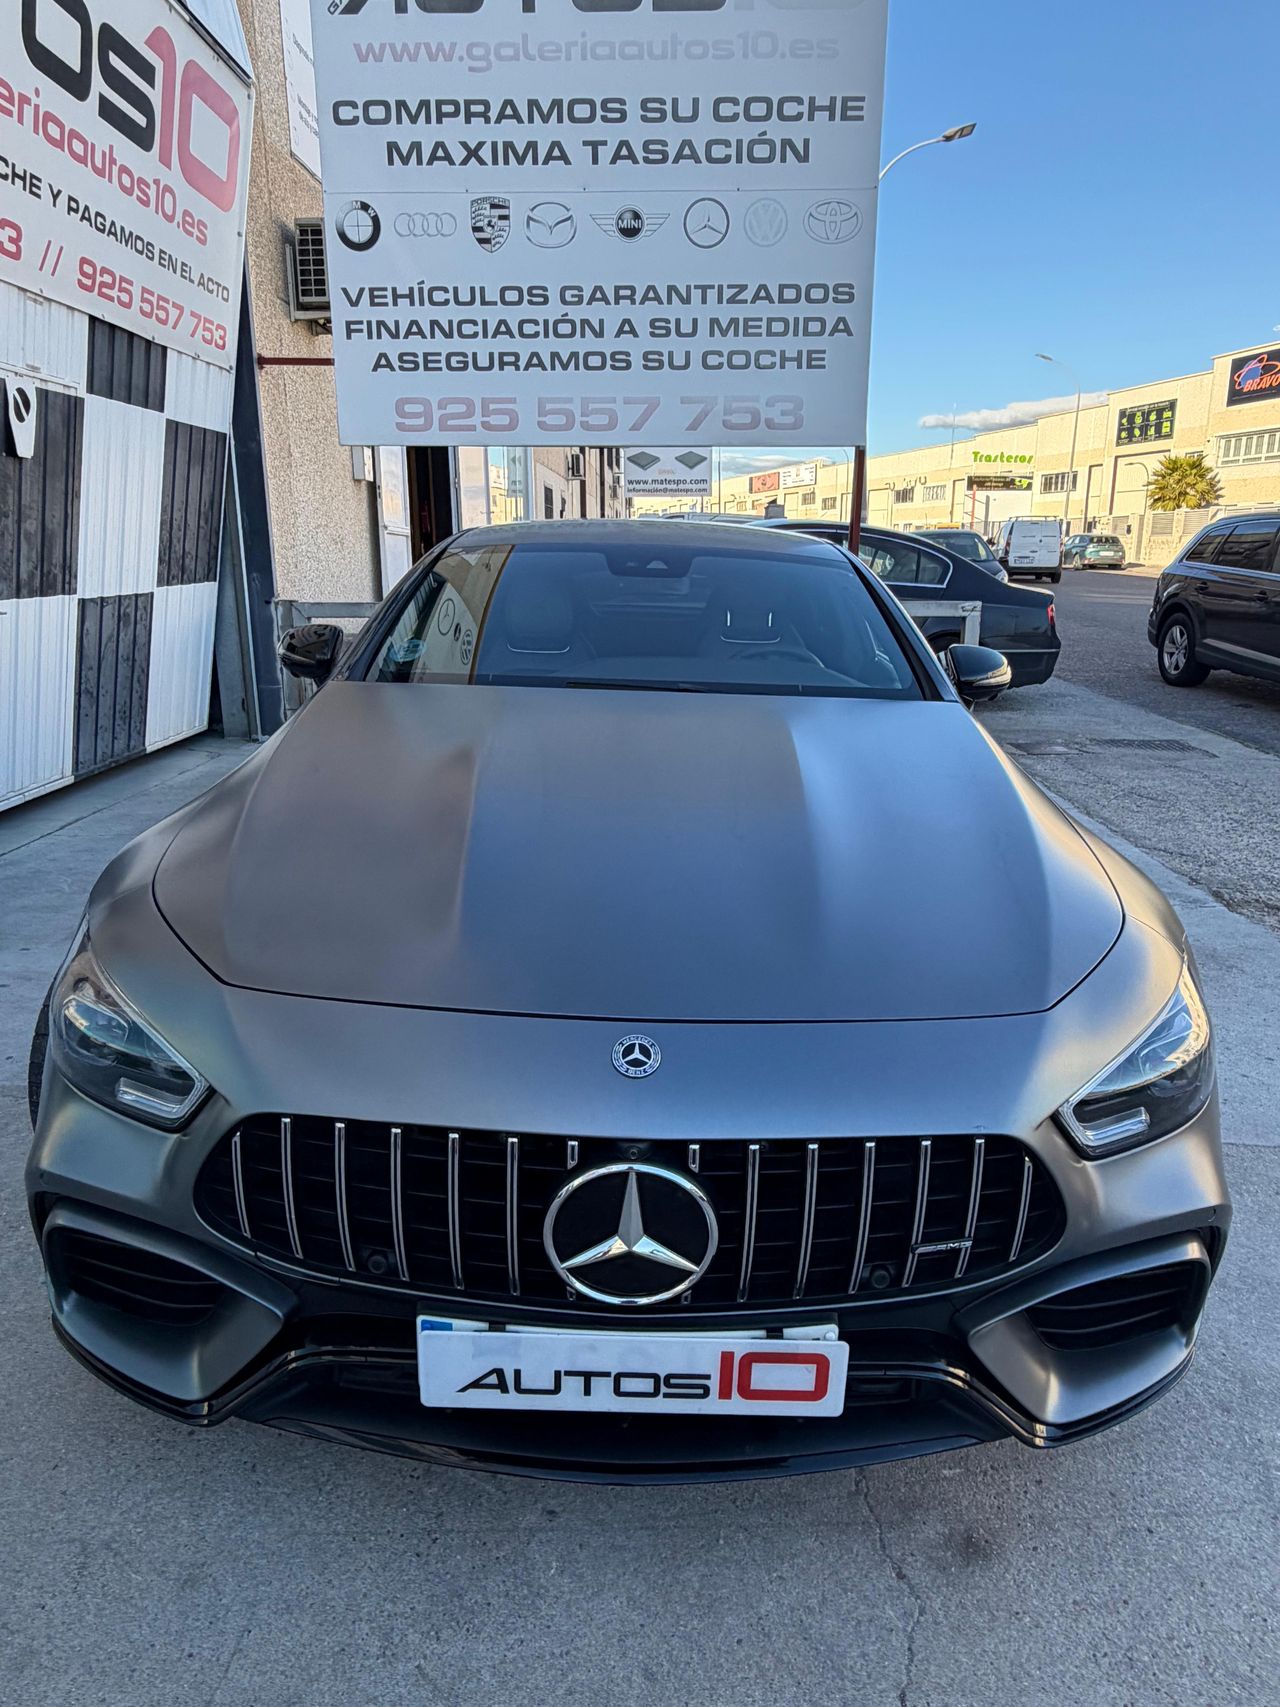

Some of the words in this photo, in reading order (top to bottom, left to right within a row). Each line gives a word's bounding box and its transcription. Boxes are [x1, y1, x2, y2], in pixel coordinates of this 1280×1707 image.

[352, 30, 840, 73] www.galeriaautos10.es
[332, 97, 627, 126] COMPRAMOS
[640, 97, 699, 124] SU
[713, 95, 867, 123] COCHE
[386, 140, 572, 167] MAXIMA
[582, 130, 811, 166] TASACIÓN
[617, 219, 642, 230] MINI
[48, 183, 62, 208] Y
[67, 194, 155, 262] PAGAMOS
[158, 247, 178, 275] EN
[180, 260, 195, 285] EL
[197, 272, 230, 303] ACTO
[0, 217, 22, 261] 3
[77, 256, 134, 310] 925
[139, 286, 185, 330] 557
[189, 310, 228, 351] 753
[341, 280, 550, 308] VEHÍCULOS
[560, 283, 856, 306] GARANTIZADOS
[345, 312, 605, 340] FINANCIACIÓN
[614, 318, 640, 338] A
[649, 318, 698, 338] SU
[709, 316, 854, 337] MEDIDA
[371, 351, 632, 373] ASEGURAMOS
[642, 351, 691, 371] SU
[702, 349, 827, 370] COCHE
[394, 397, 519, 432] 925
[537, 396, 661, 432] 557
[680, 396, 804, 432] 753
[972, 451, 1034, 464] Trasteros
[627, 478, 708, 486] www.matespo.com
[456, 1350, 831, 1402] AUTOS10
